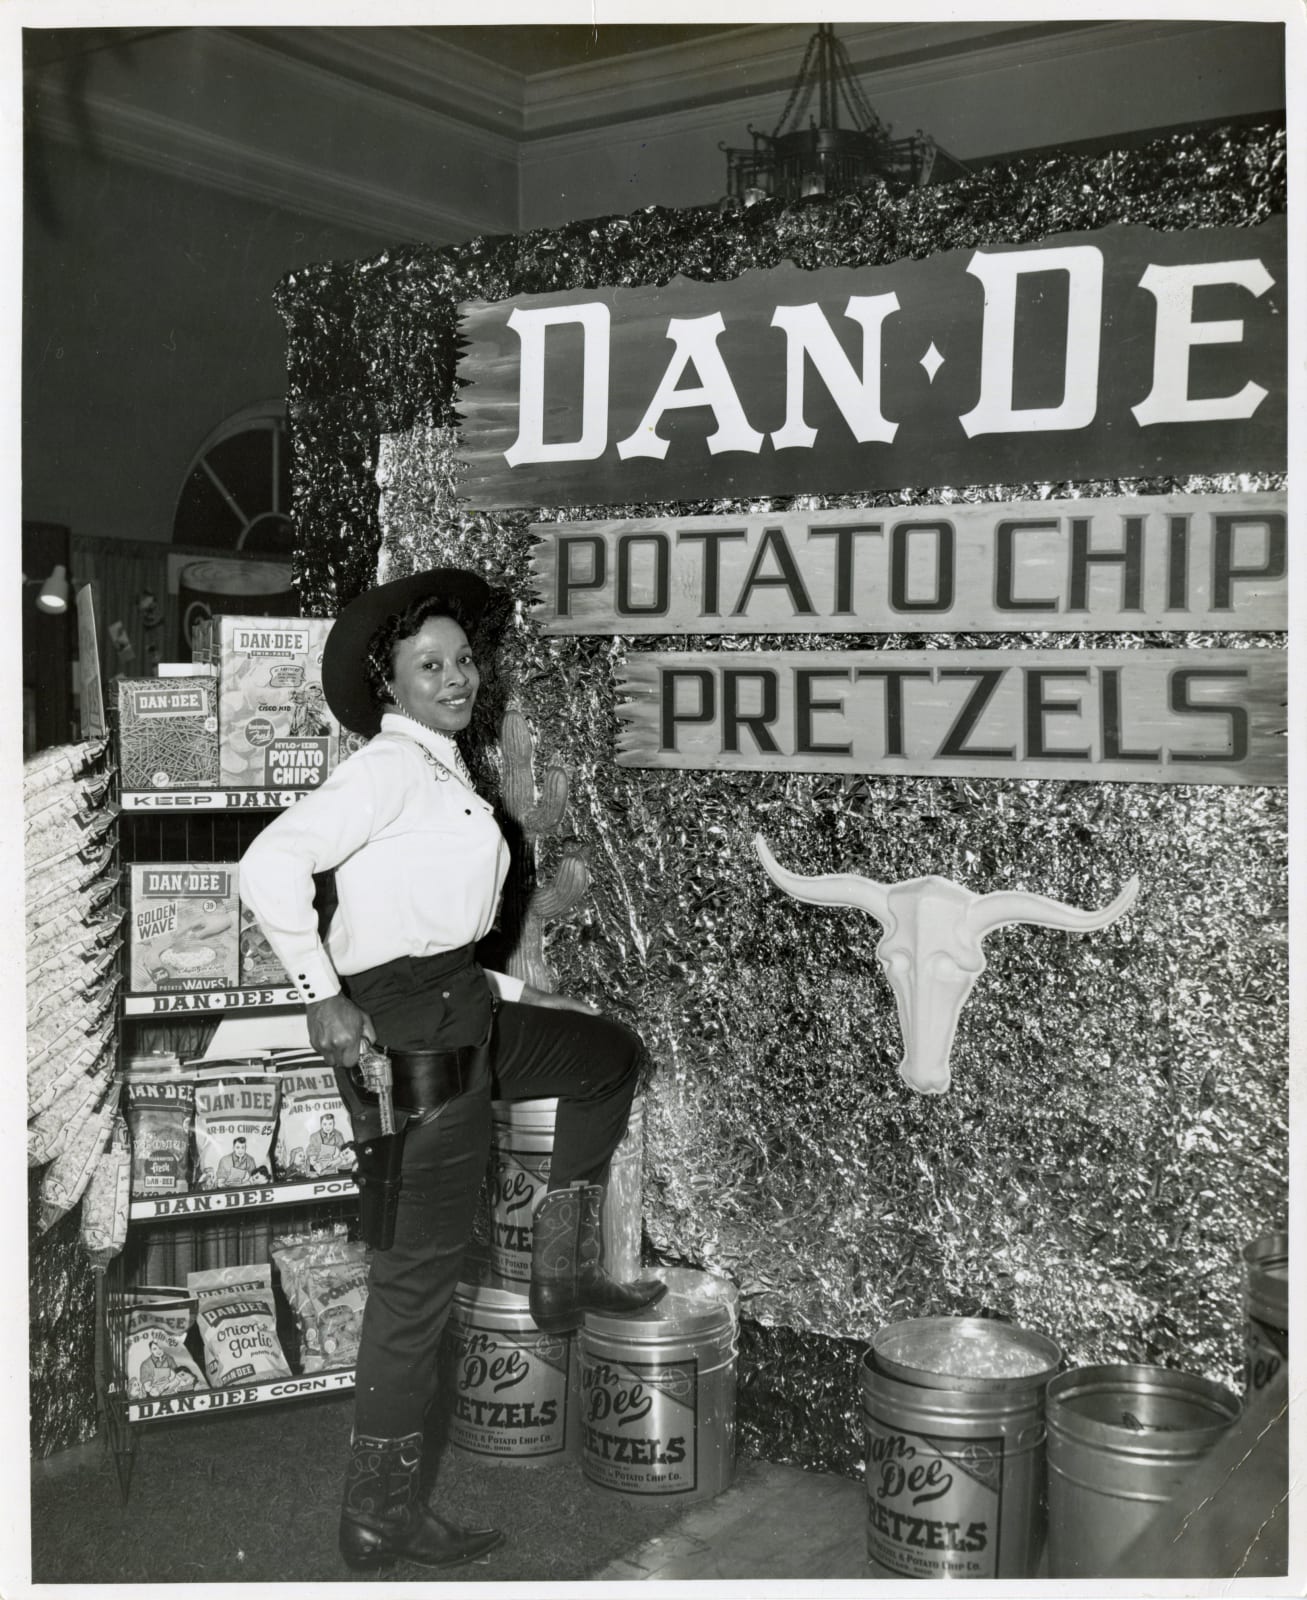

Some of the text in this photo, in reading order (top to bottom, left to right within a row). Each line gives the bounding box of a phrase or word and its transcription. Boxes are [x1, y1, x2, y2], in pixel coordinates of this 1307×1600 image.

[554, 508, 1287, 618] POTATO CHIP
[658, 664, 1250, 764] PRETZELS
[268, 750, 324, 767] POTATO
[272, 767, 320, 785] CHIPS
[134, 796, 213, 806] KEEP
[137, 903, 176, 927] GOLDEN
[139, 917, 175, 940] WAVE
[182, 979, 223, 991] WAVES
[237, 1124, 261, 1134] CHIPS
[261, 1126, 273, 1136] 25
[229, 1331, 273, 1359] garlic
[459, 1350, 530, 1394] Dee
[270, 1376, 328, 1396] CORN
[587, 1383, 653, 1427] Dee
[877, 1459, 953, 1507] Dee
